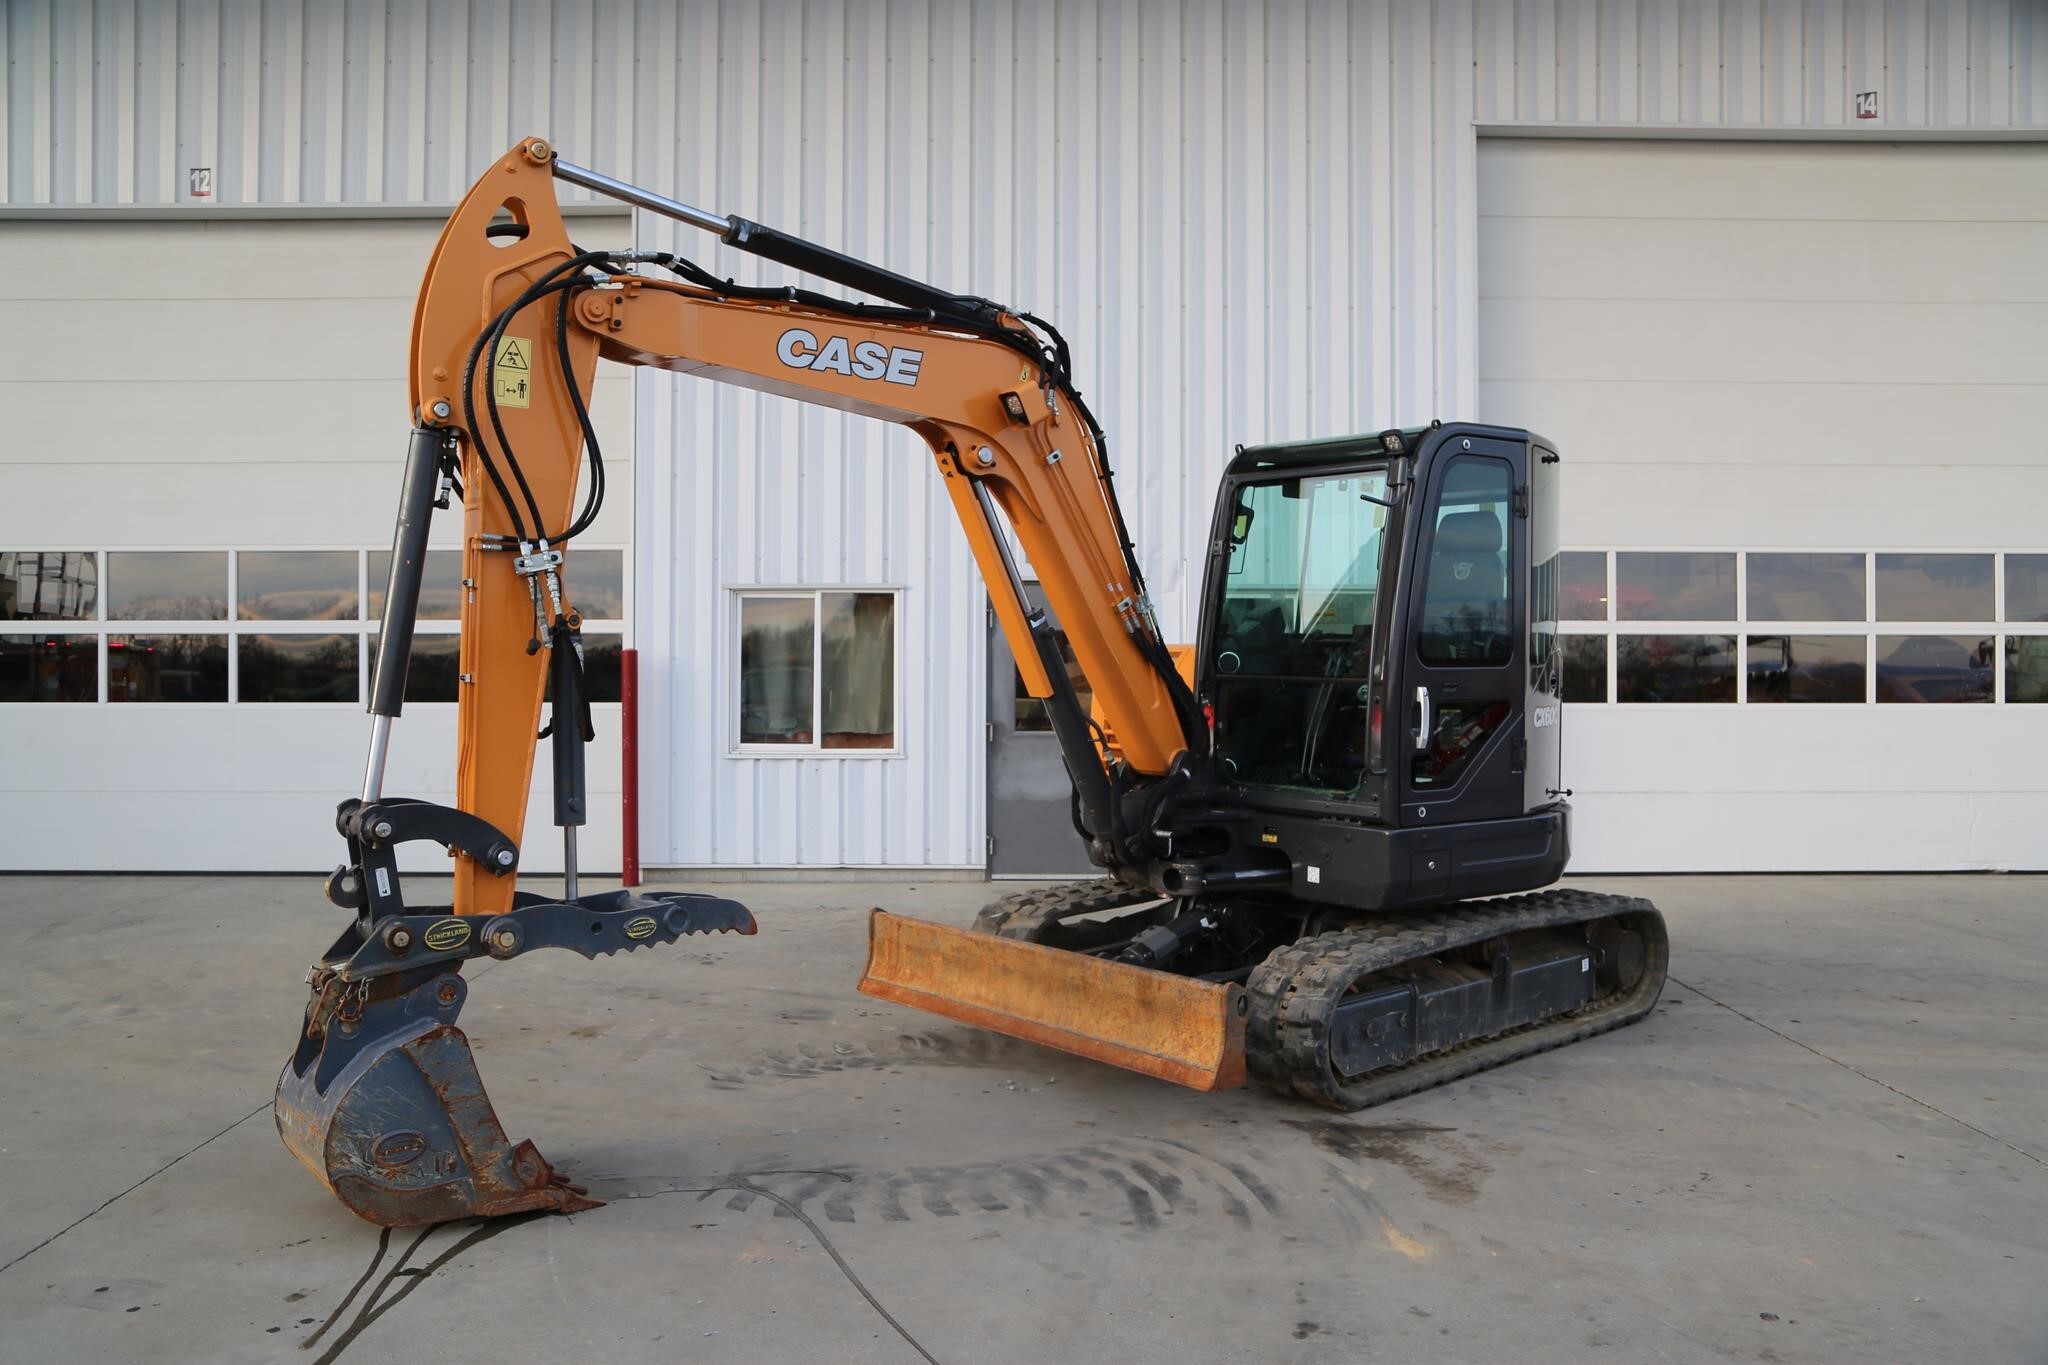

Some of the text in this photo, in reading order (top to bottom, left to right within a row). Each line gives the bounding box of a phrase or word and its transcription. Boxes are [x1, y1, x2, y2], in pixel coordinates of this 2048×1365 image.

[1857, 92, 1877, 115] 14
[191, 169, 210, 192] 12
[776, 328, 924, 386] CASE
[428, 927, 469, 942] STRICKLAND
